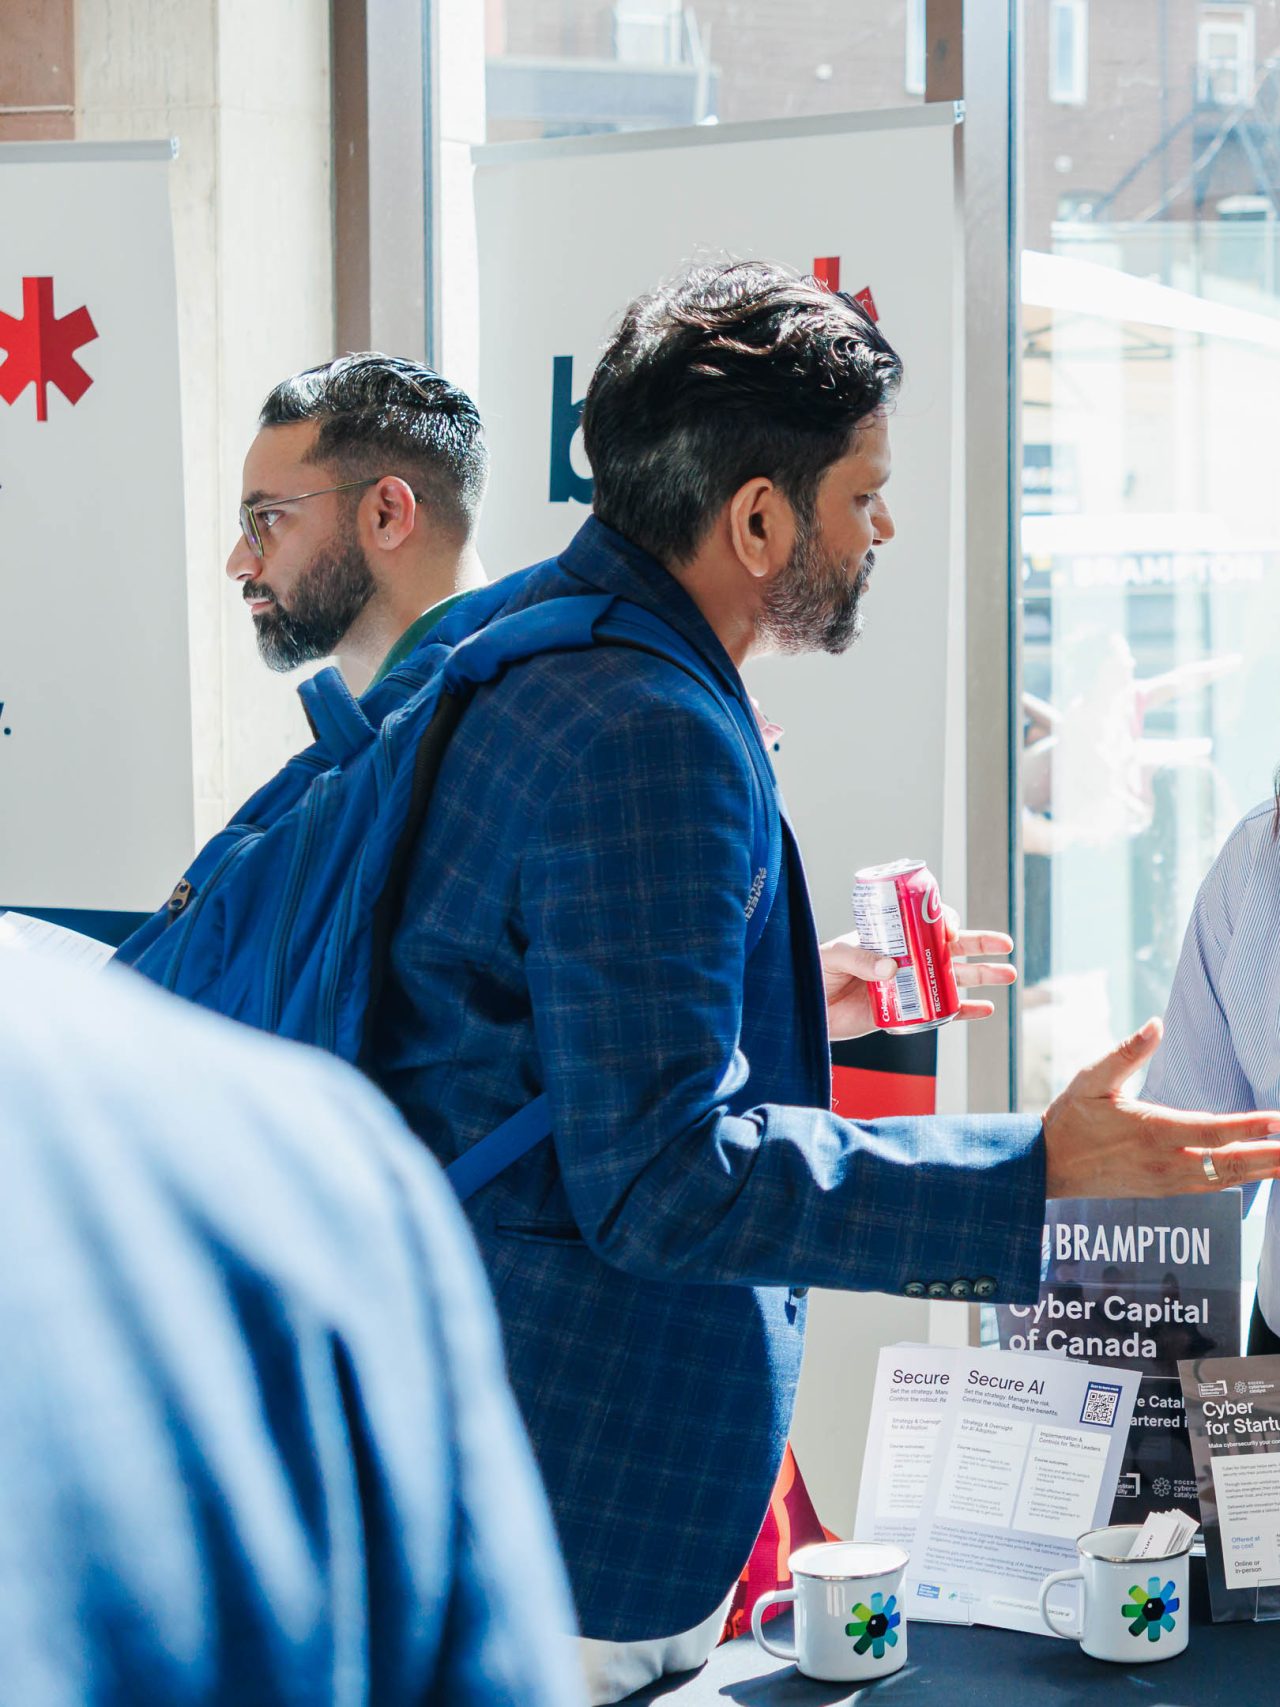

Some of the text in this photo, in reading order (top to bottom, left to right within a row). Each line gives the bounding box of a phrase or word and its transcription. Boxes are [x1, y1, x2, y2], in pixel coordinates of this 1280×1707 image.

[930, 979, 942, 1013] RECYCLE
[1055, 1223, 1210, 1266] BRAMPTON
[1009, 1292, 1209, 1328] Cyber Capital
[1008, 1328, 1157, 1358] of Canada
[891, 1369, 950, 1385] Secure
[967, 1370, 1046, 1395] Secure AI
[962, 1396, 981, 1404] Control
[1012, 1403, 1025, 1412] Reap
[1008, 1394, 1029, 1404] Manage
[1149, 1395, 1185, 1409] Catal
[1202, 1400, 1254, 1419] Cyber
[1130, 1416, 1181, 1428] artered
[1205, 1422, 1230, 1436] for
[1040, 1431, 1078, 1442] Implementation
[1231, 1536, 1254, 1544] Offered
